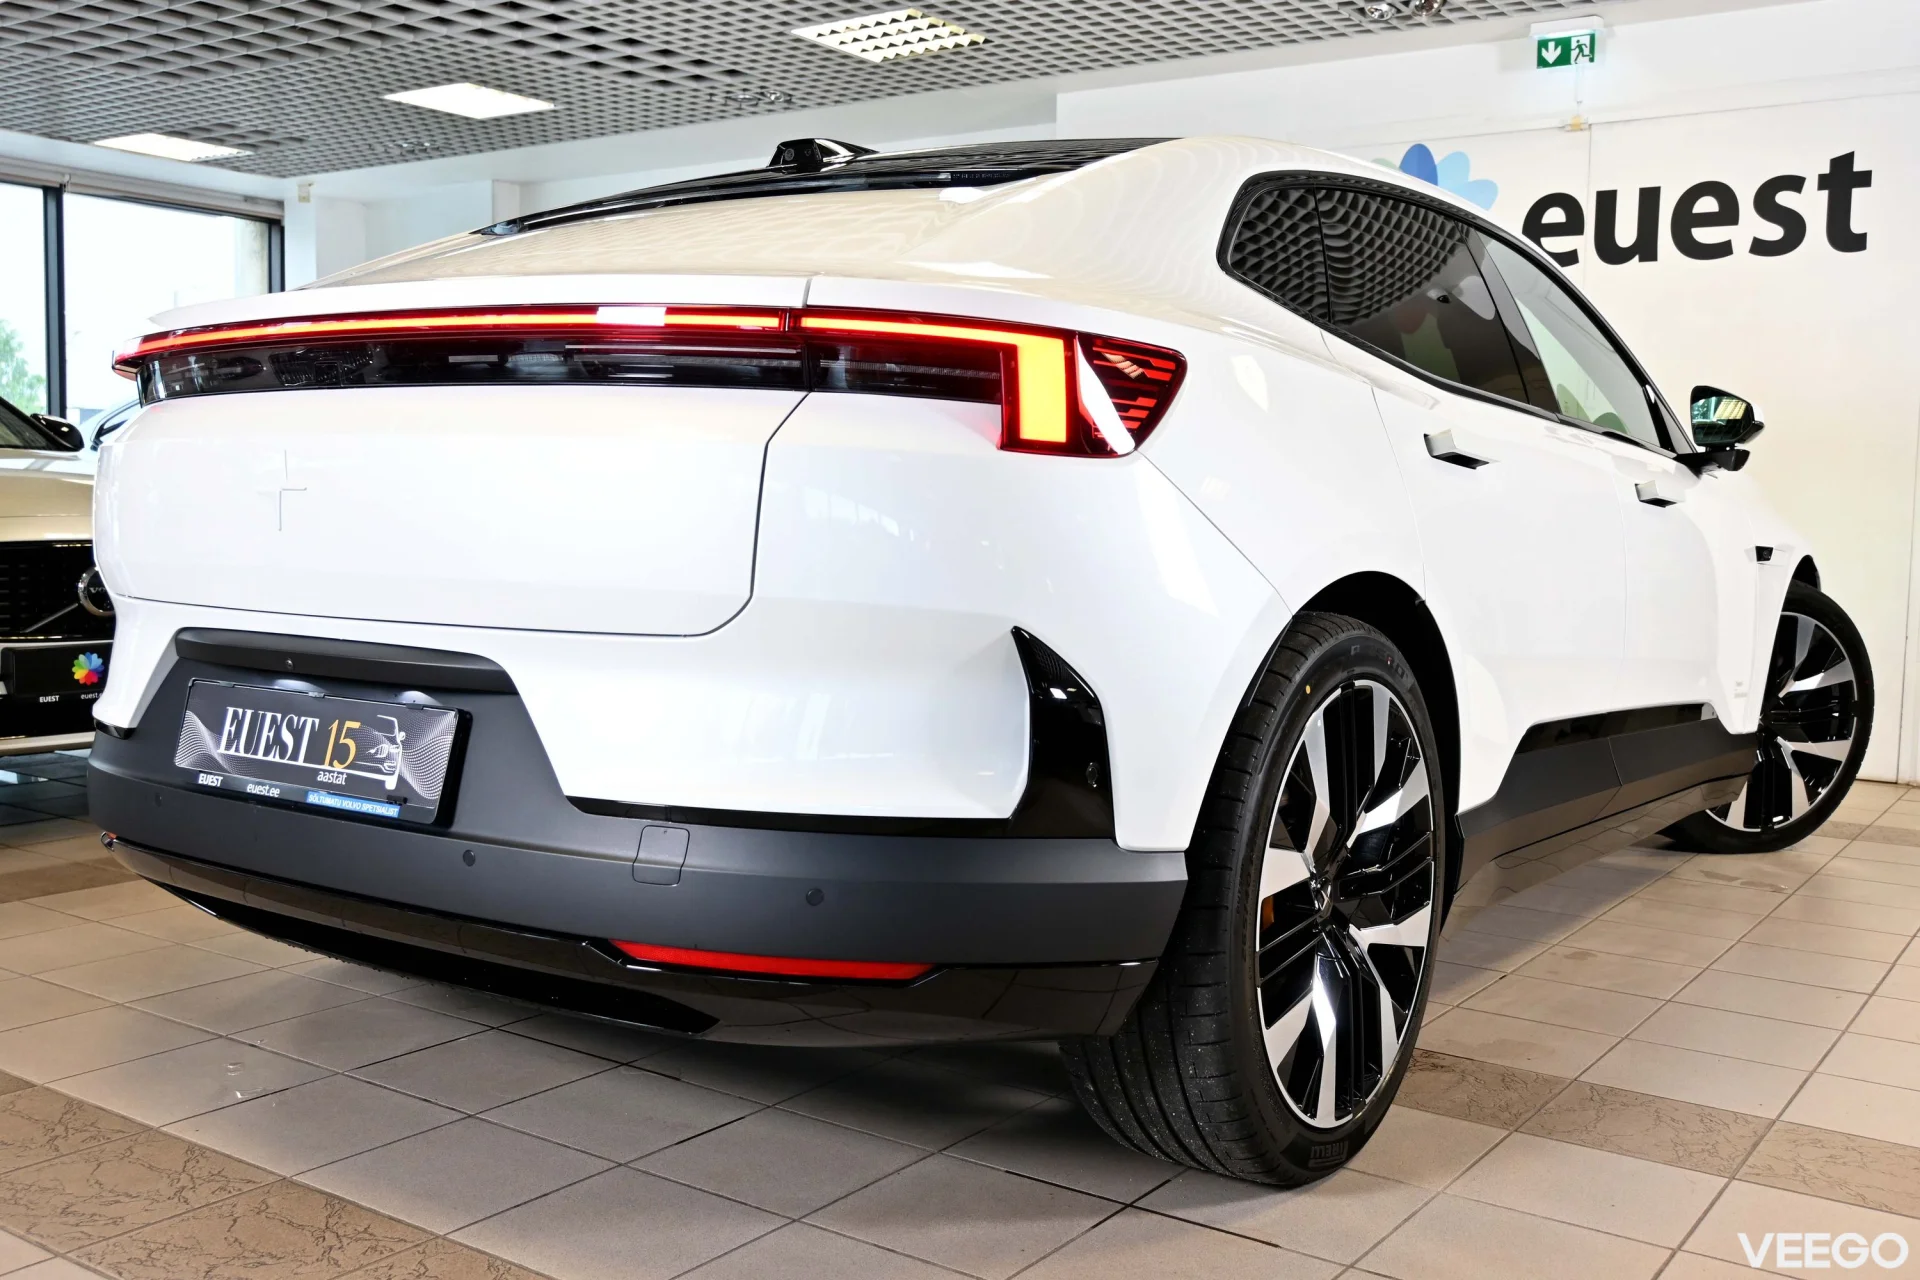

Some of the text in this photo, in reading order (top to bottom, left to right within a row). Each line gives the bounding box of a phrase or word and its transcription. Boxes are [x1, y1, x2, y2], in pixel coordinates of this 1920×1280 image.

[1521, 151, 1873, 268] euest
[39, 695, 60, 703] EUEST
[81, 692, 103, 700] euest.
[217, 706, 361, 769] EUEST 15
[198, 773, 224, 787] EUEST
[317, 770, 348, 785] aastat
[246, 783, 281, 798] euest.ee
[342, 798, 362, 810] VOLVO
[361, 802, 399, 817] SPETSIALIST
